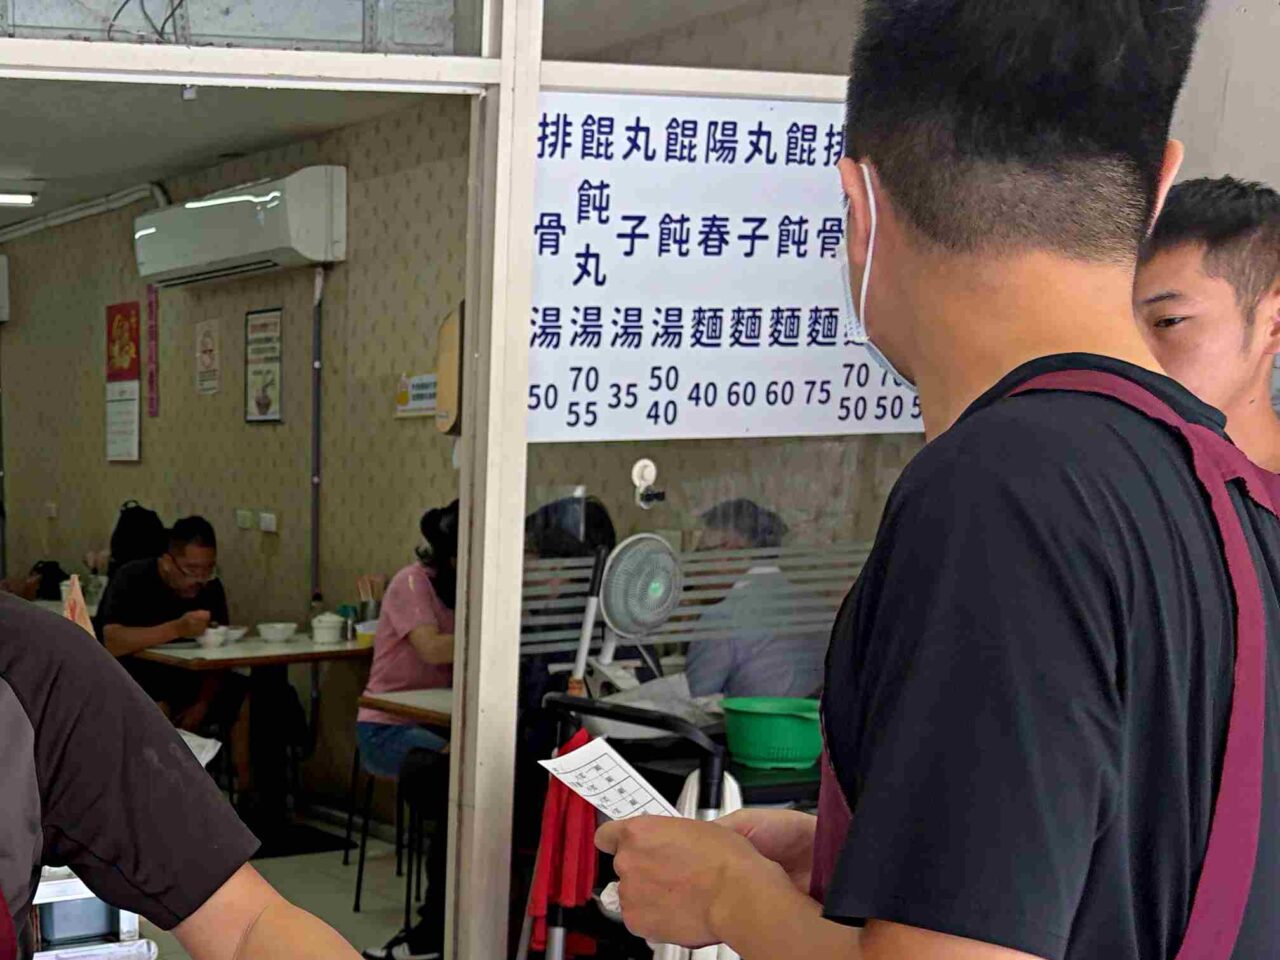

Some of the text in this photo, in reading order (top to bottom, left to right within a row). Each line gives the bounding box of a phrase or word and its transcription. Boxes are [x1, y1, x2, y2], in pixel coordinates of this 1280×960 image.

[608, 117, 656, 408] 丸子湯 35
[688, 120, 738, 406] 陽春麵 40
[727, 121, 777, 406] 丸子麵 60
[569, 367, 598, 392] 70
[649, 366, 678, 391] 50
[843, 363, 870, 387] 70
[528, 384, 558, 409] 50
[766, 381, 794, 405] 60
[804, 380, 831, 404] 75
[566, 402, 598, 426] 55
[646, 401, 677, 425] 40
[838, 397, 867, 420] 50
[874, 396, 903, 420] 50
